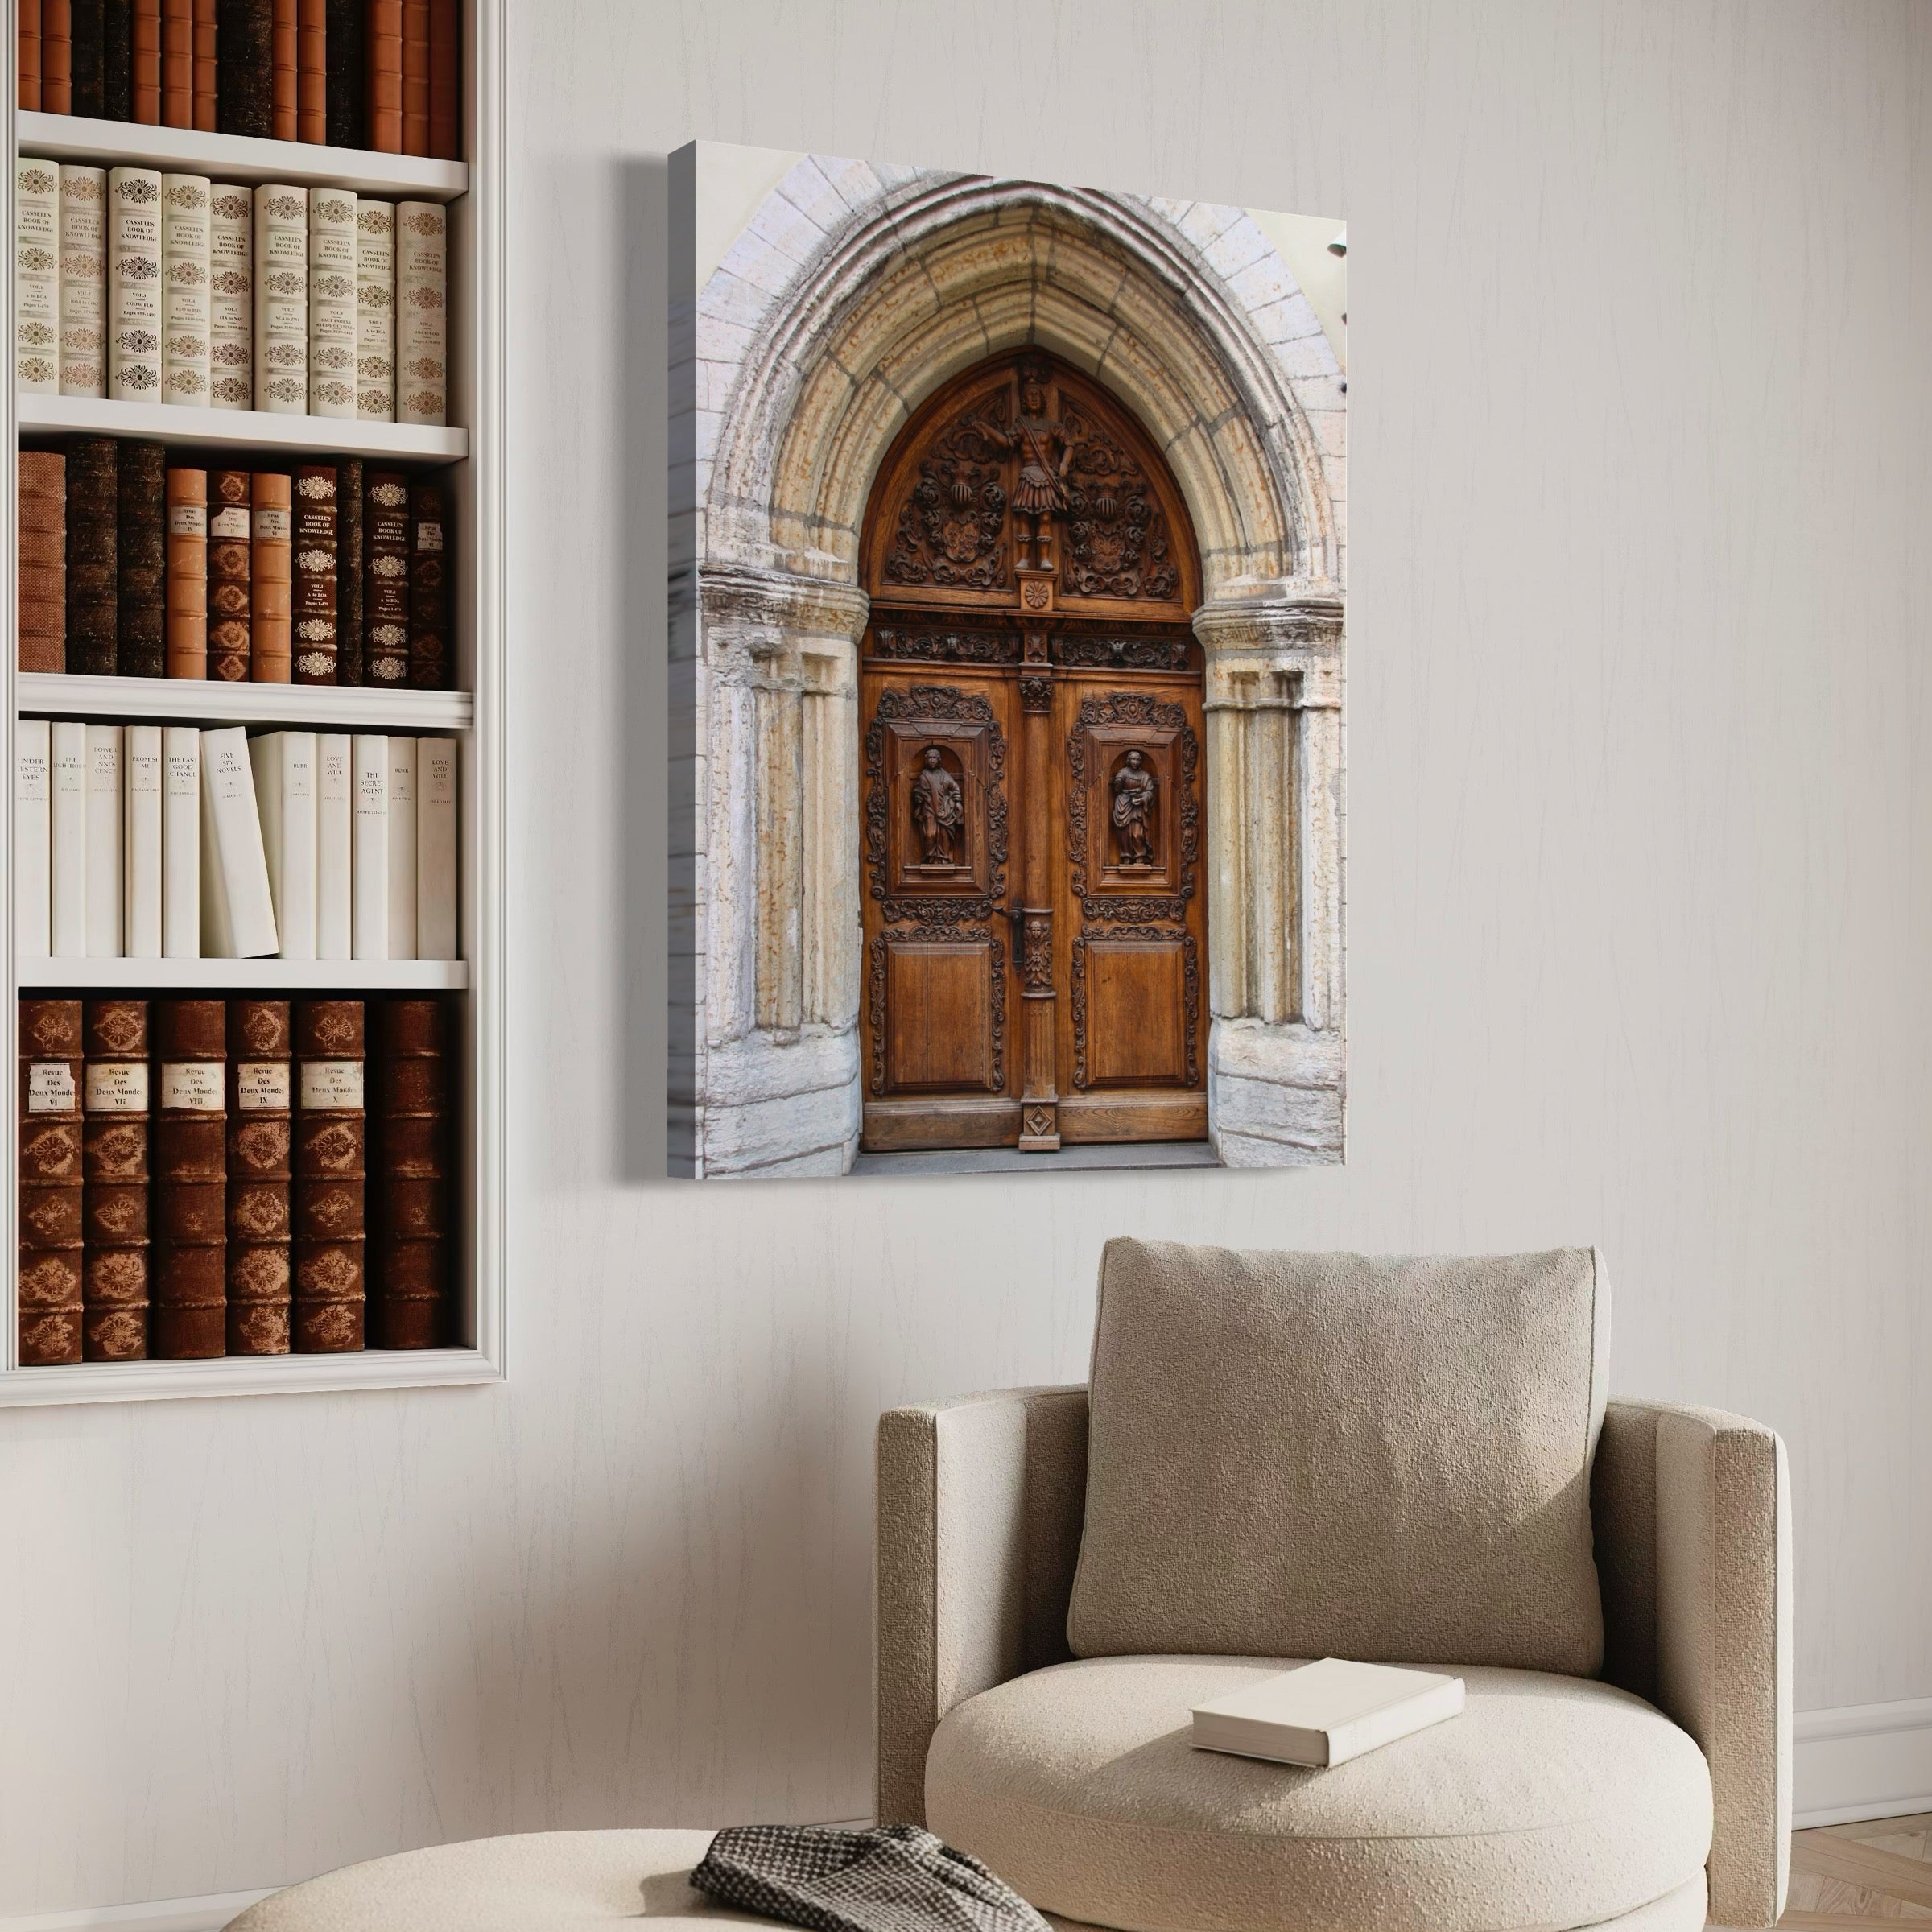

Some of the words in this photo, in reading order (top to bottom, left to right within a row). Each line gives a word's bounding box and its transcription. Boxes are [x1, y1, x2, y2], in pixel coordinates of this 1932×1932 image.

[121, 233, 157, 242] KNOWLEDGE
[299, 527, 334, 535] KNOWLEDGE
[217, 766, 242, 774] NOVELS
[260, 1087, 284, 1095] Mondes
